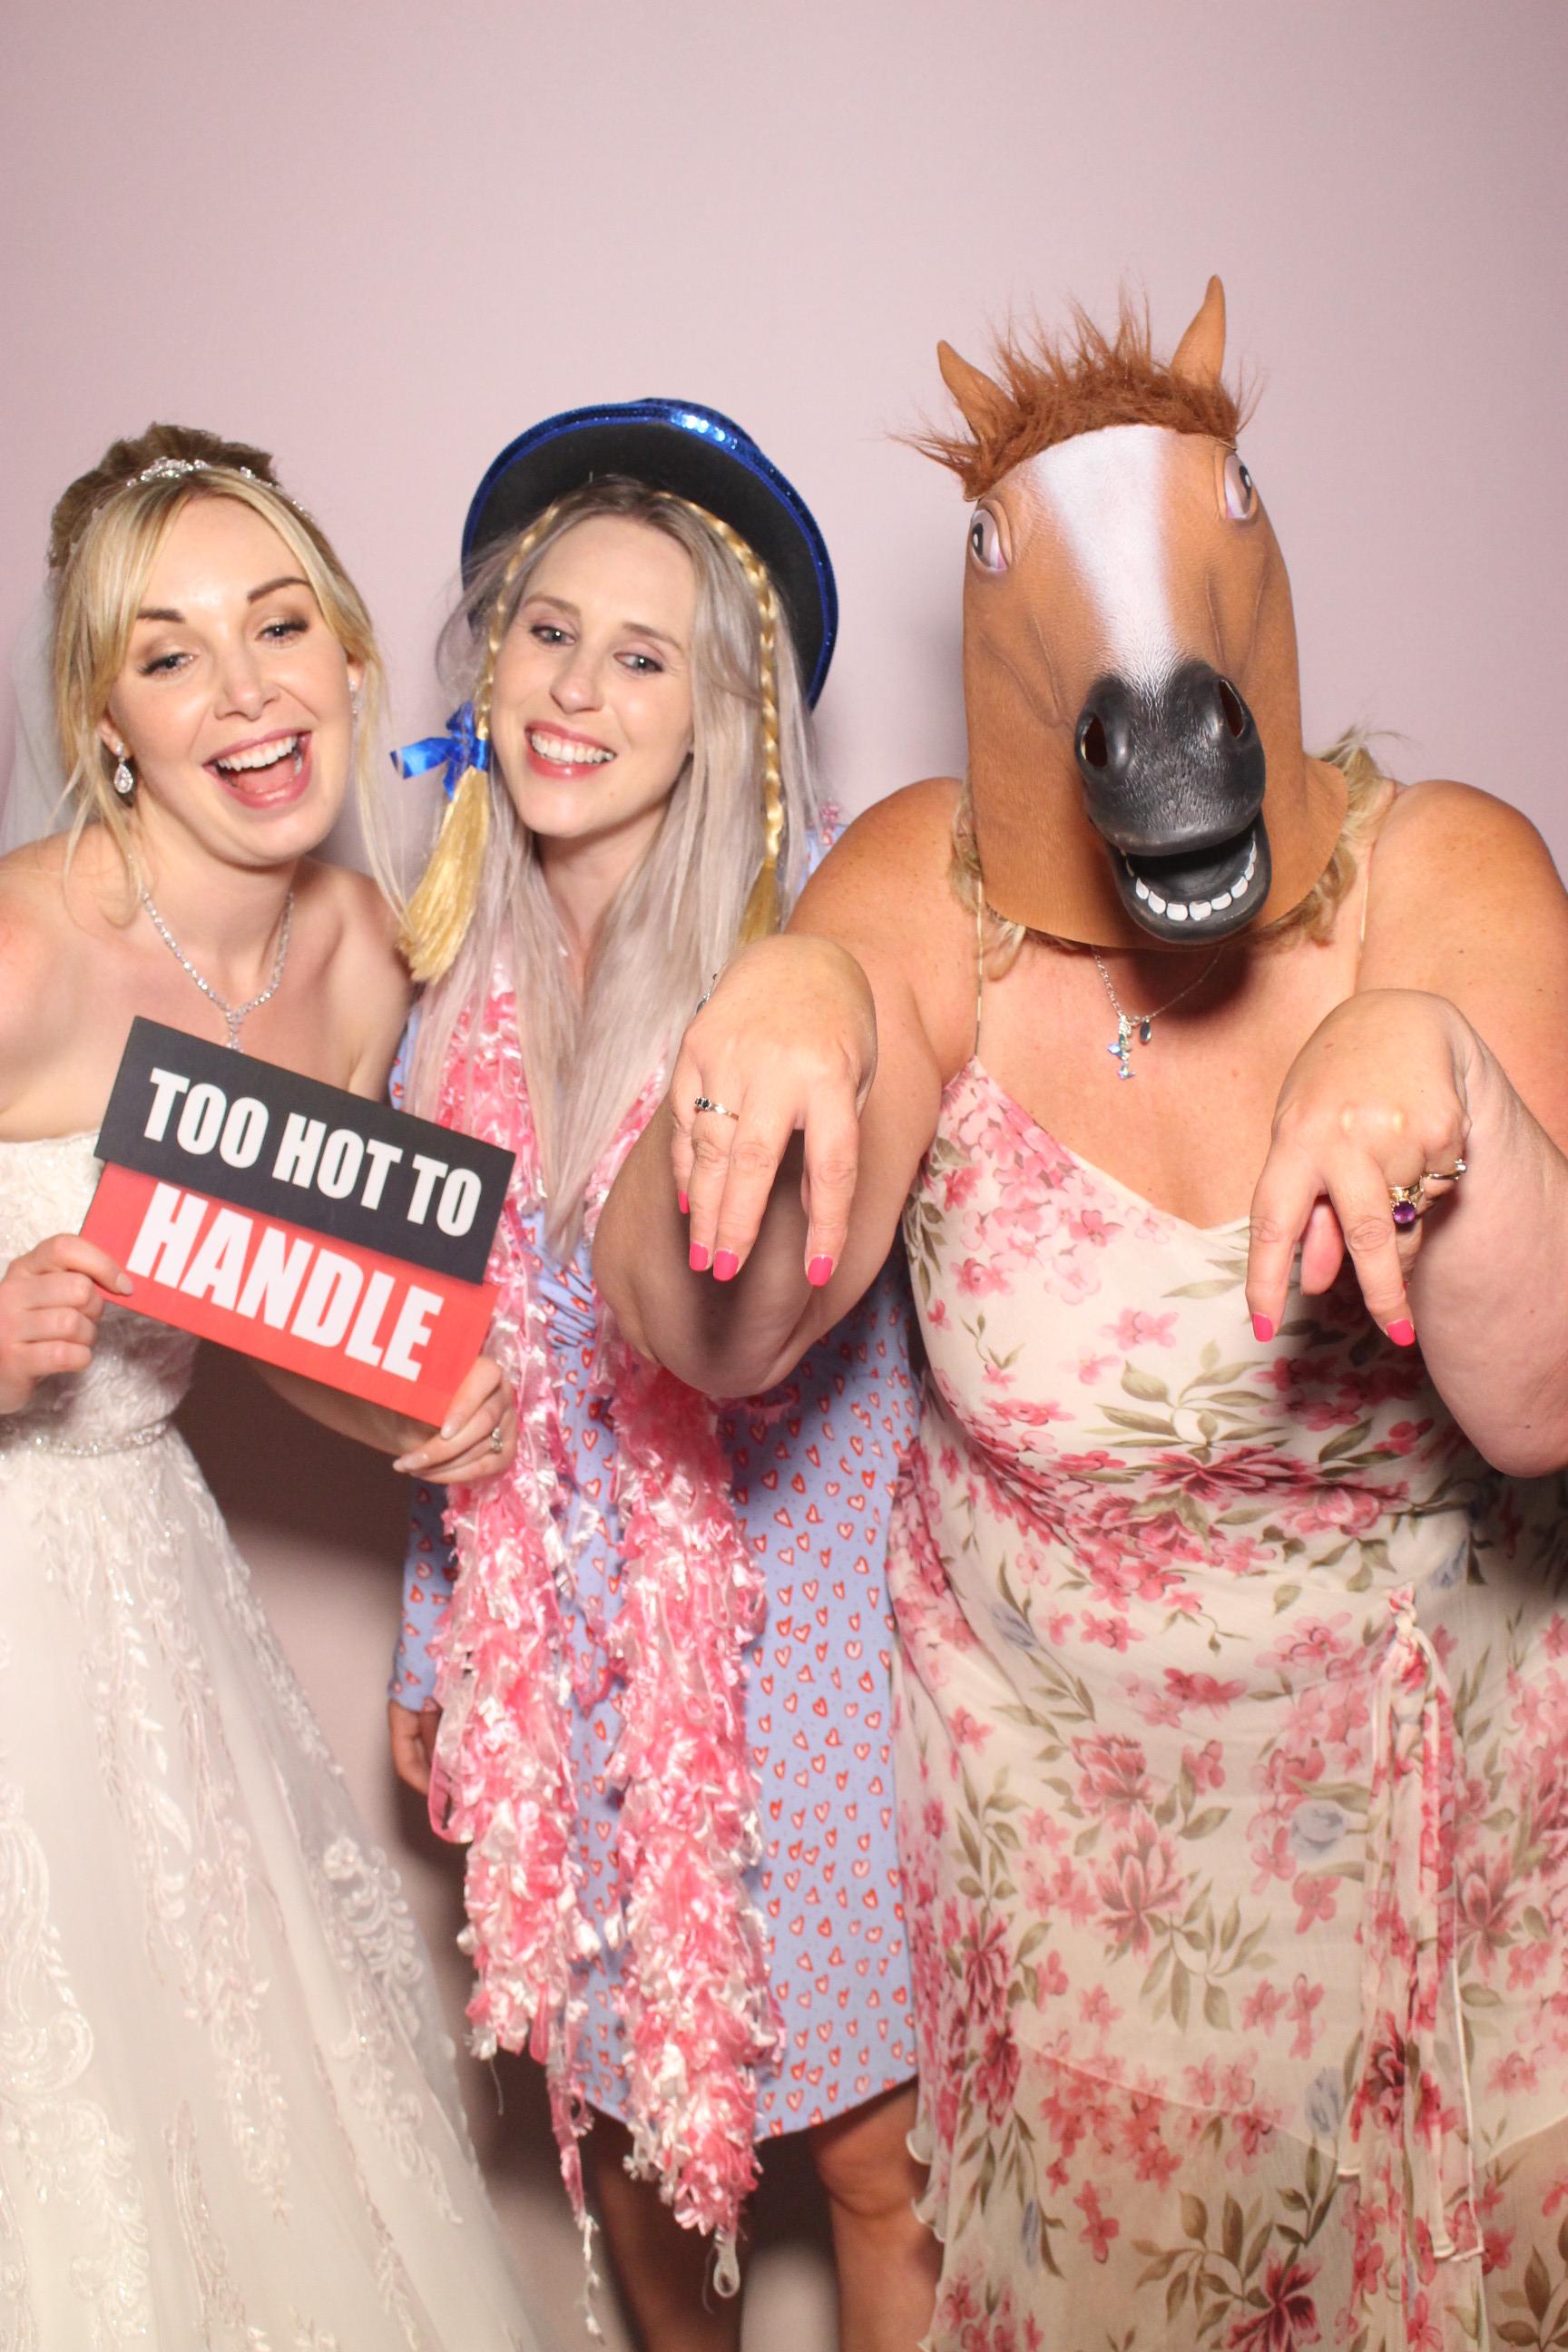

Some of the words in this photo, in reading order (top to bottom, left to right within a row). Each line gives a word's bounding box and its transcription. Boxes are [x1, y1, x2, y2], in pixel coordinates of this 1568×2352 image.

[143, 1067, 270, 1169] TOO
[272, 1112, 404, 1210] HOT
[407, 1153, 482, 1237] TO
[125, 1181, 445, 1382] HANDLE
